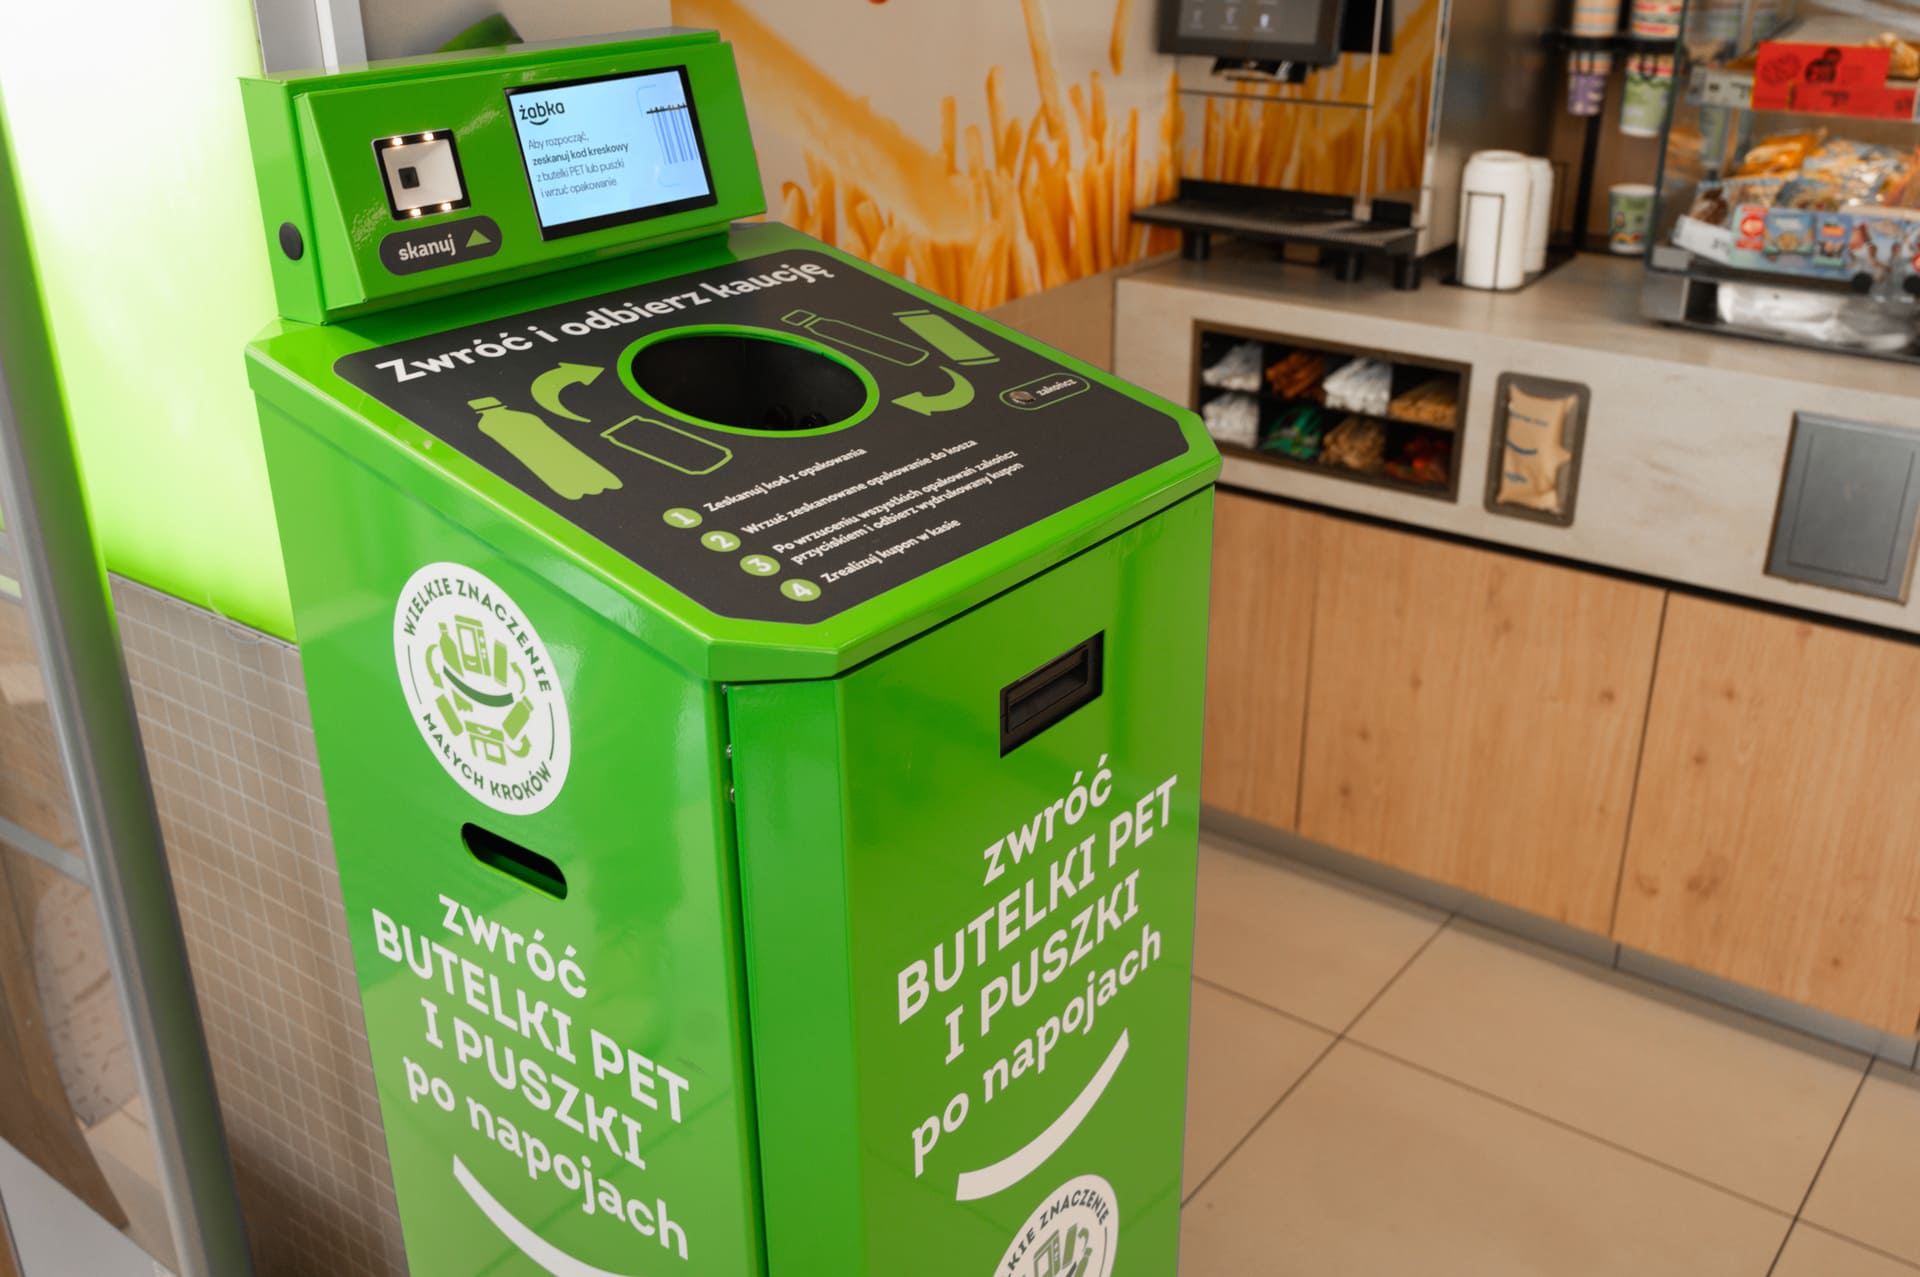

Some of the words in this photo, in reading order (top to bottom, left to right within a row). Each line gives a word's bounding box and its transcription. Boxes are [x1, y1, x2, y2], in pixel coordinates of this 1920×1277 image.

[519, 100, 565, 120] żabka
[528, 139, 544, 151] Aby
[545, 131, 589, 147] rozpocząć,
[532, 150, 570, 166] zeskanuj
[570, 147, 587, 159] kod
[587, 143, 629, 156] kreskowy
[542, 168, 569, 181] butelki
[569, 164, 584, 176] PET
[586, 162, 599, 174] lub
[600, 158, 625, 174] puszki
[545, 184, 569, 198] wrzuć
[570, 177, 617, 195] opakowanie
[398, 233, 457, 262] skanuj
[376, 331, 534, 383] Zwróć
[528, 325, 557, 343] i
[560, 290, 712, 338] odbierz
[703, 261, 835, 300] kaucję
[1036, 379, 1078, 396] zakończ
[671, 512, 695, 526] 1
[703, 484, 769, 512] Zeskanuj
[761, 475, 791, 490] kod
[788, 473, 800, 481] z
[798, 448, 868, 477] opakowania
[709, 534, 735, 549] 2
[740, 513, 788, 534] Wrzuć
[786, 482, 868, 518] zeskanowane
[866, 457, 933, 486] opakowanie
[930, 451, 947, 461] do
[942, 440, 978, 455] kosza
[747, 557, 772, 573] 3
[772, 543, 795, 554] Po
[793, 516, 861, 545] wrzuceniu
[858, 487, 923, 519] wszystkich
[922, 466, 977, 493] opakowań
[975, 450, 1018, 471] zakończ
[791, 525, 869, 565] przyciskiem
[864, 524, 875, 532] i
[873, 507, 919, 529] odbierz
[915, 475, 992, 509] wydrukowany
[986, 463, 1024, 480] kupon
[792, 583, 813, 597] 4
[820, 552, 883, 584] Zrealizuj
[876, 537, 919, 555] kupon
[916, 532, 930, 542] w
[926, 519, 961, 537] kasie
[403, 577, 452, 637] WIELKIE
[456, 579, 552, 692] ZNACZENIE
[422, 713, 484, 789] MAŁYCH
[490, 761, 552, 801] KROKÓW
[983, 753, 1113, 886] zwróć
[438, 893, 587, 998] zwróć
[897, 834, 1096, 1025] BUTELKI
[1108, 773, 1179, 868] PET
[372, 908, 576, 1065] BUTELKI
[591, 1028, 689, 1123] PET
[945, 1004, 965, 1065] I
[981, 868, 1140, 1037] PUSZKI
[421, 997, 443, 1049] I
[453, 1017, 646, 1170] PUSZKI
[911, 1092, 969, 1178] po
[982, 923, 1162, 1103] napojach
[403, 1056, 455, 1112] po
[466, 1097, 689, 1260] napojach
[1040, 1188, 1110, 1231] ZNACZENIE
